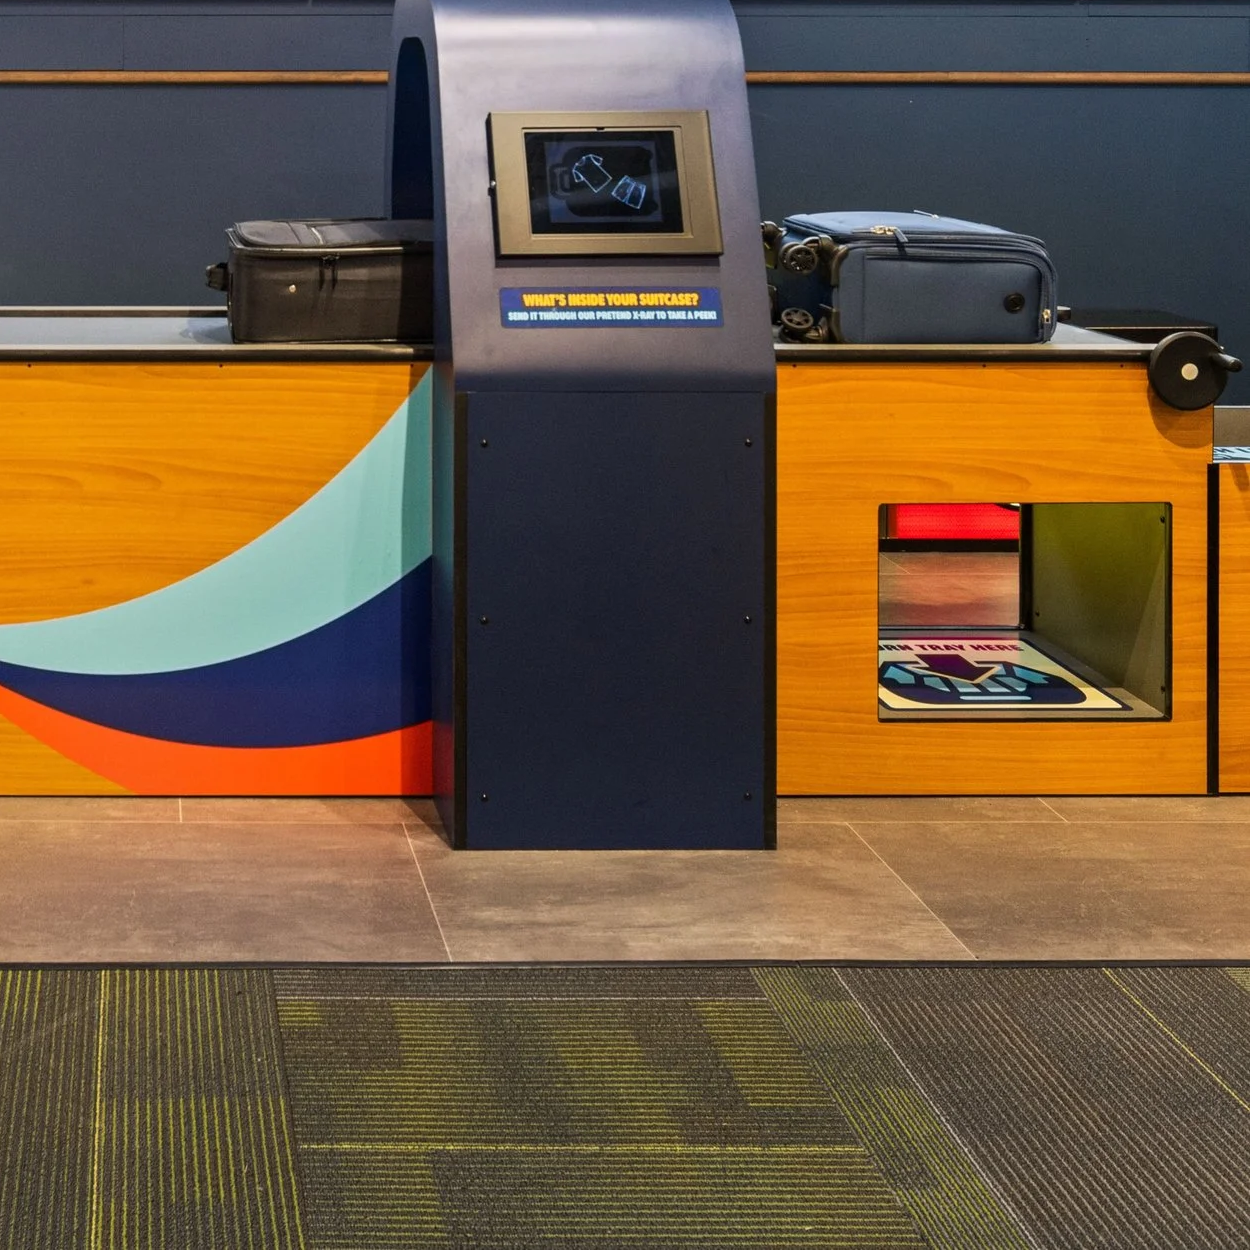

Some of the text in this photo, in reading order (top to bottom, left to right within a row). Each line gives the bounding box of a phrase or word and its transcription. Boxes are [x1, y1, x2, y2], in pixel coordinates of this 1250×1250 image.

[522, 293, 699, 306] WHAT'S INSIDE YOUR SUITCASE?
[508, 311, 529, 320] SEND
[530, 311, 538, 320] IT
[538, 311, 576, 320] THROUGH
[578, 311, 595, 320] OUR
[596, 311, 632, 320] PRETEND
[656, 311, 666, 320] TO
[687, 311, 694, 320] A
